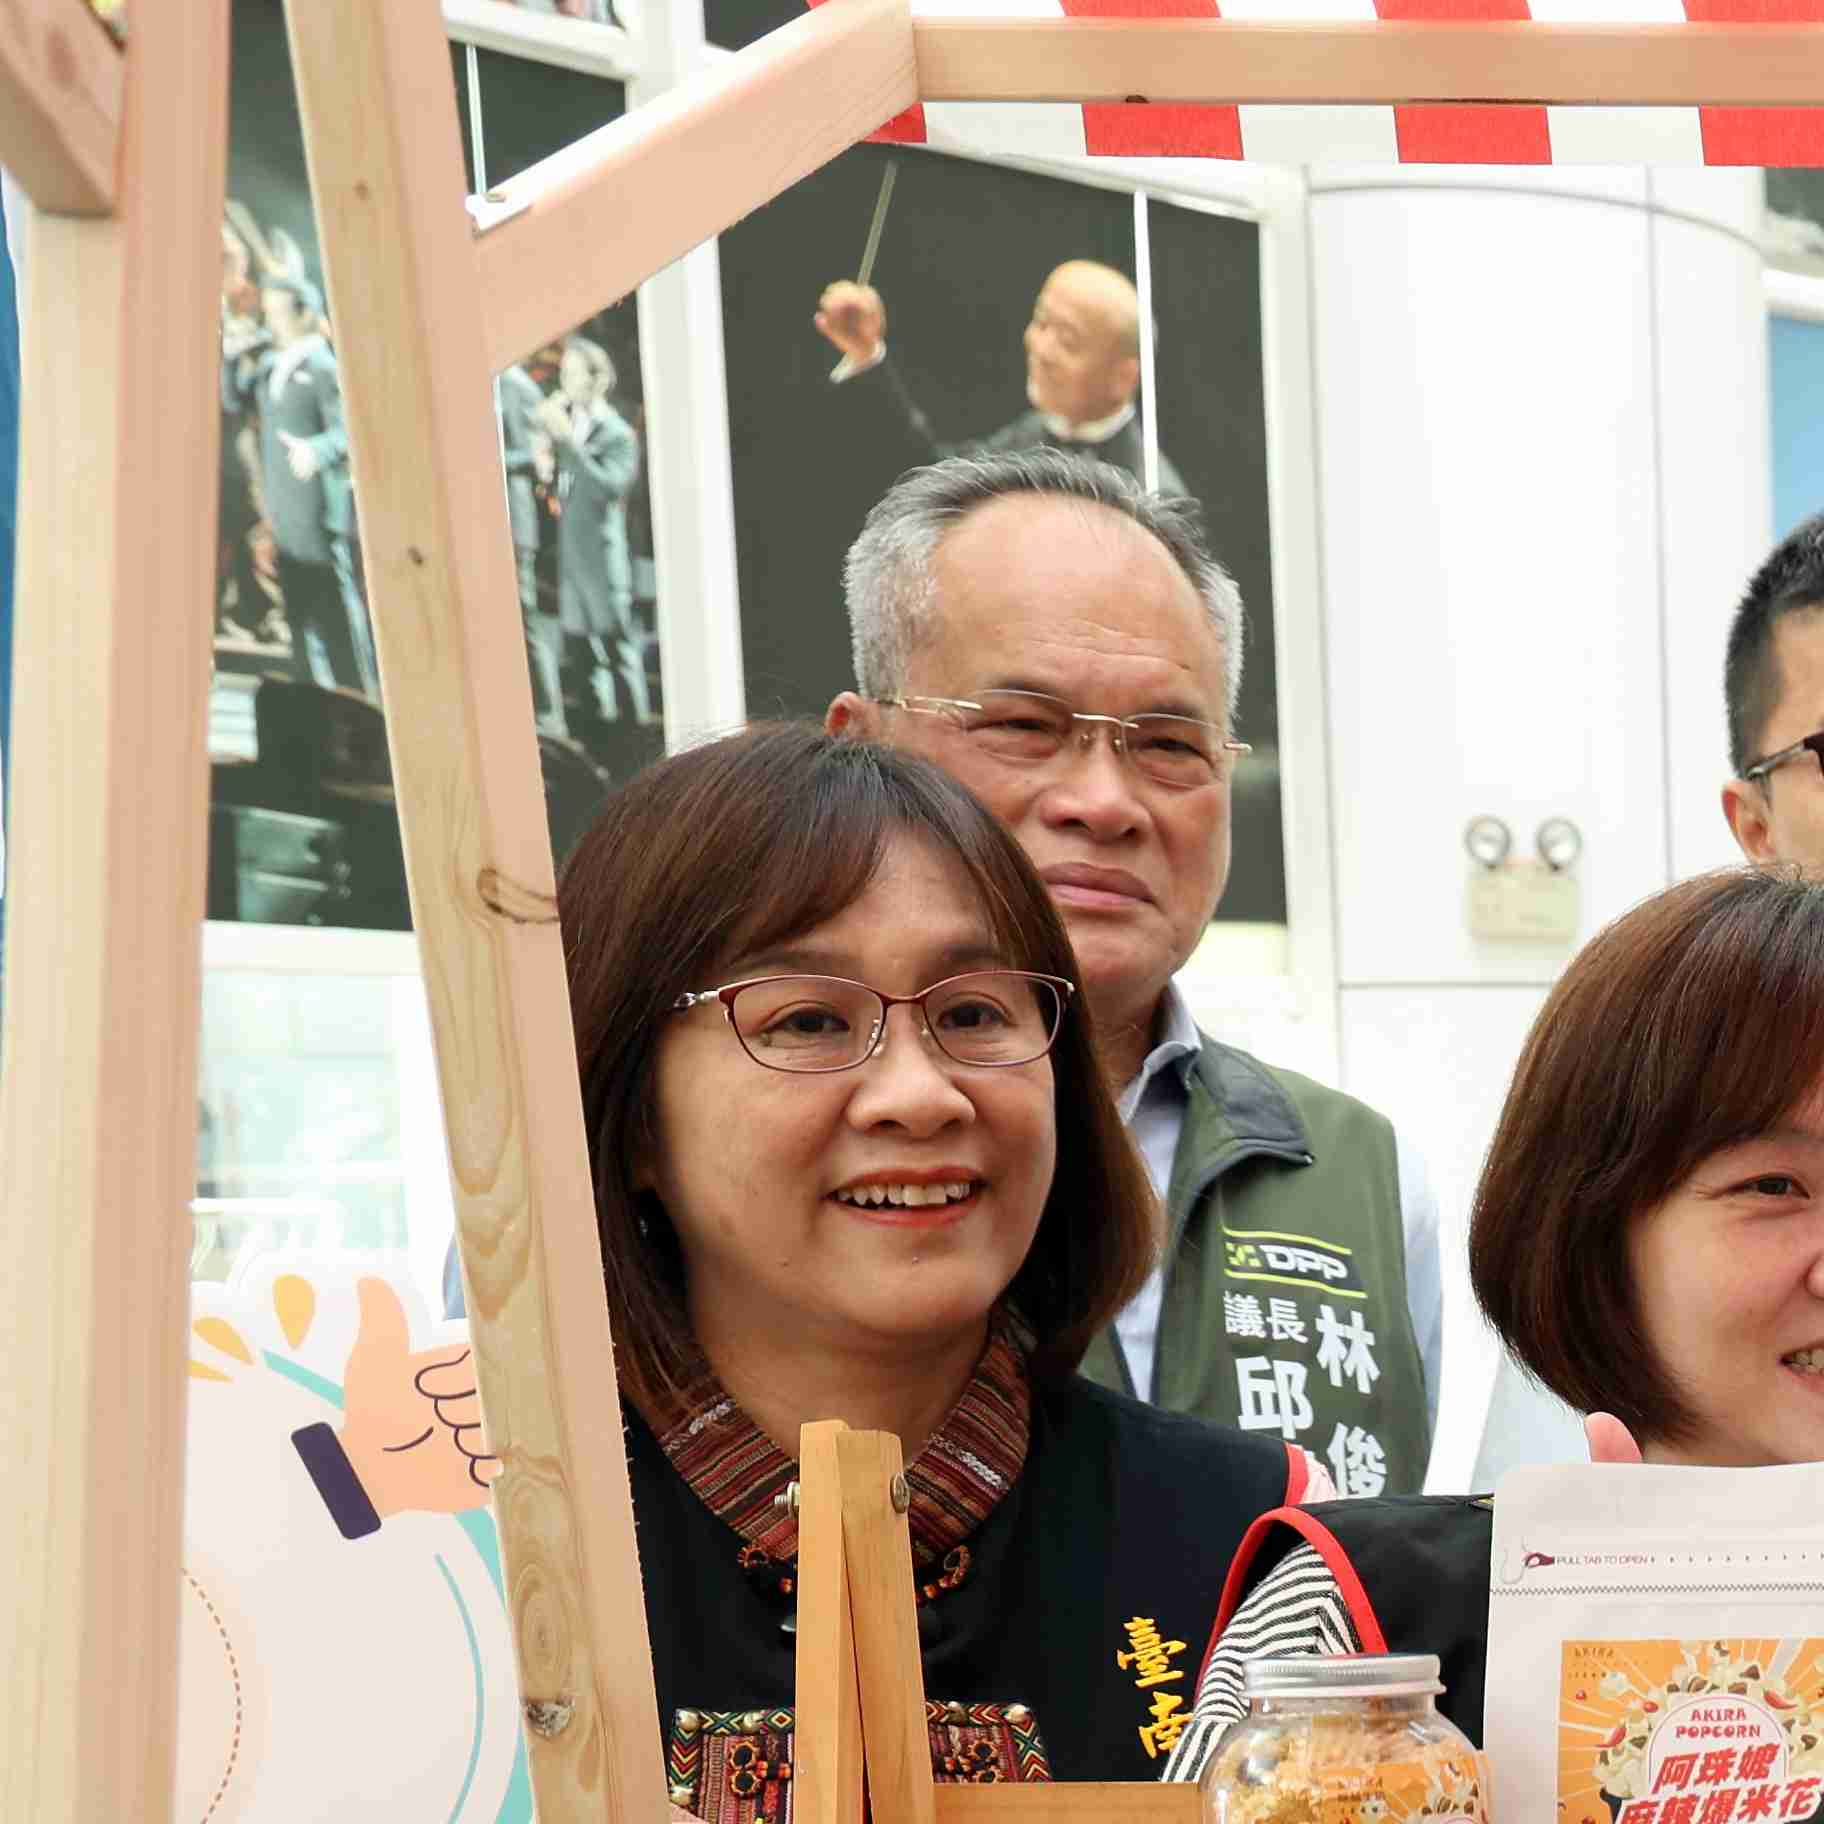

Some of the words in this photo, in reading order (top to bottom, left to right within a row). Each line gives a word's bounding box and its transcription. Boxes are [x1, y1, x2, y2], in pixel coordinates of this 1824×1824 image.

[1260, 1244, 1348, 1280] DPP
[1223, 1291, 1309, 1343] 議長
[1691, 1709, 1747, 1721] AKIRA
[1676, 1725, 1760, 1738] POPCORN
